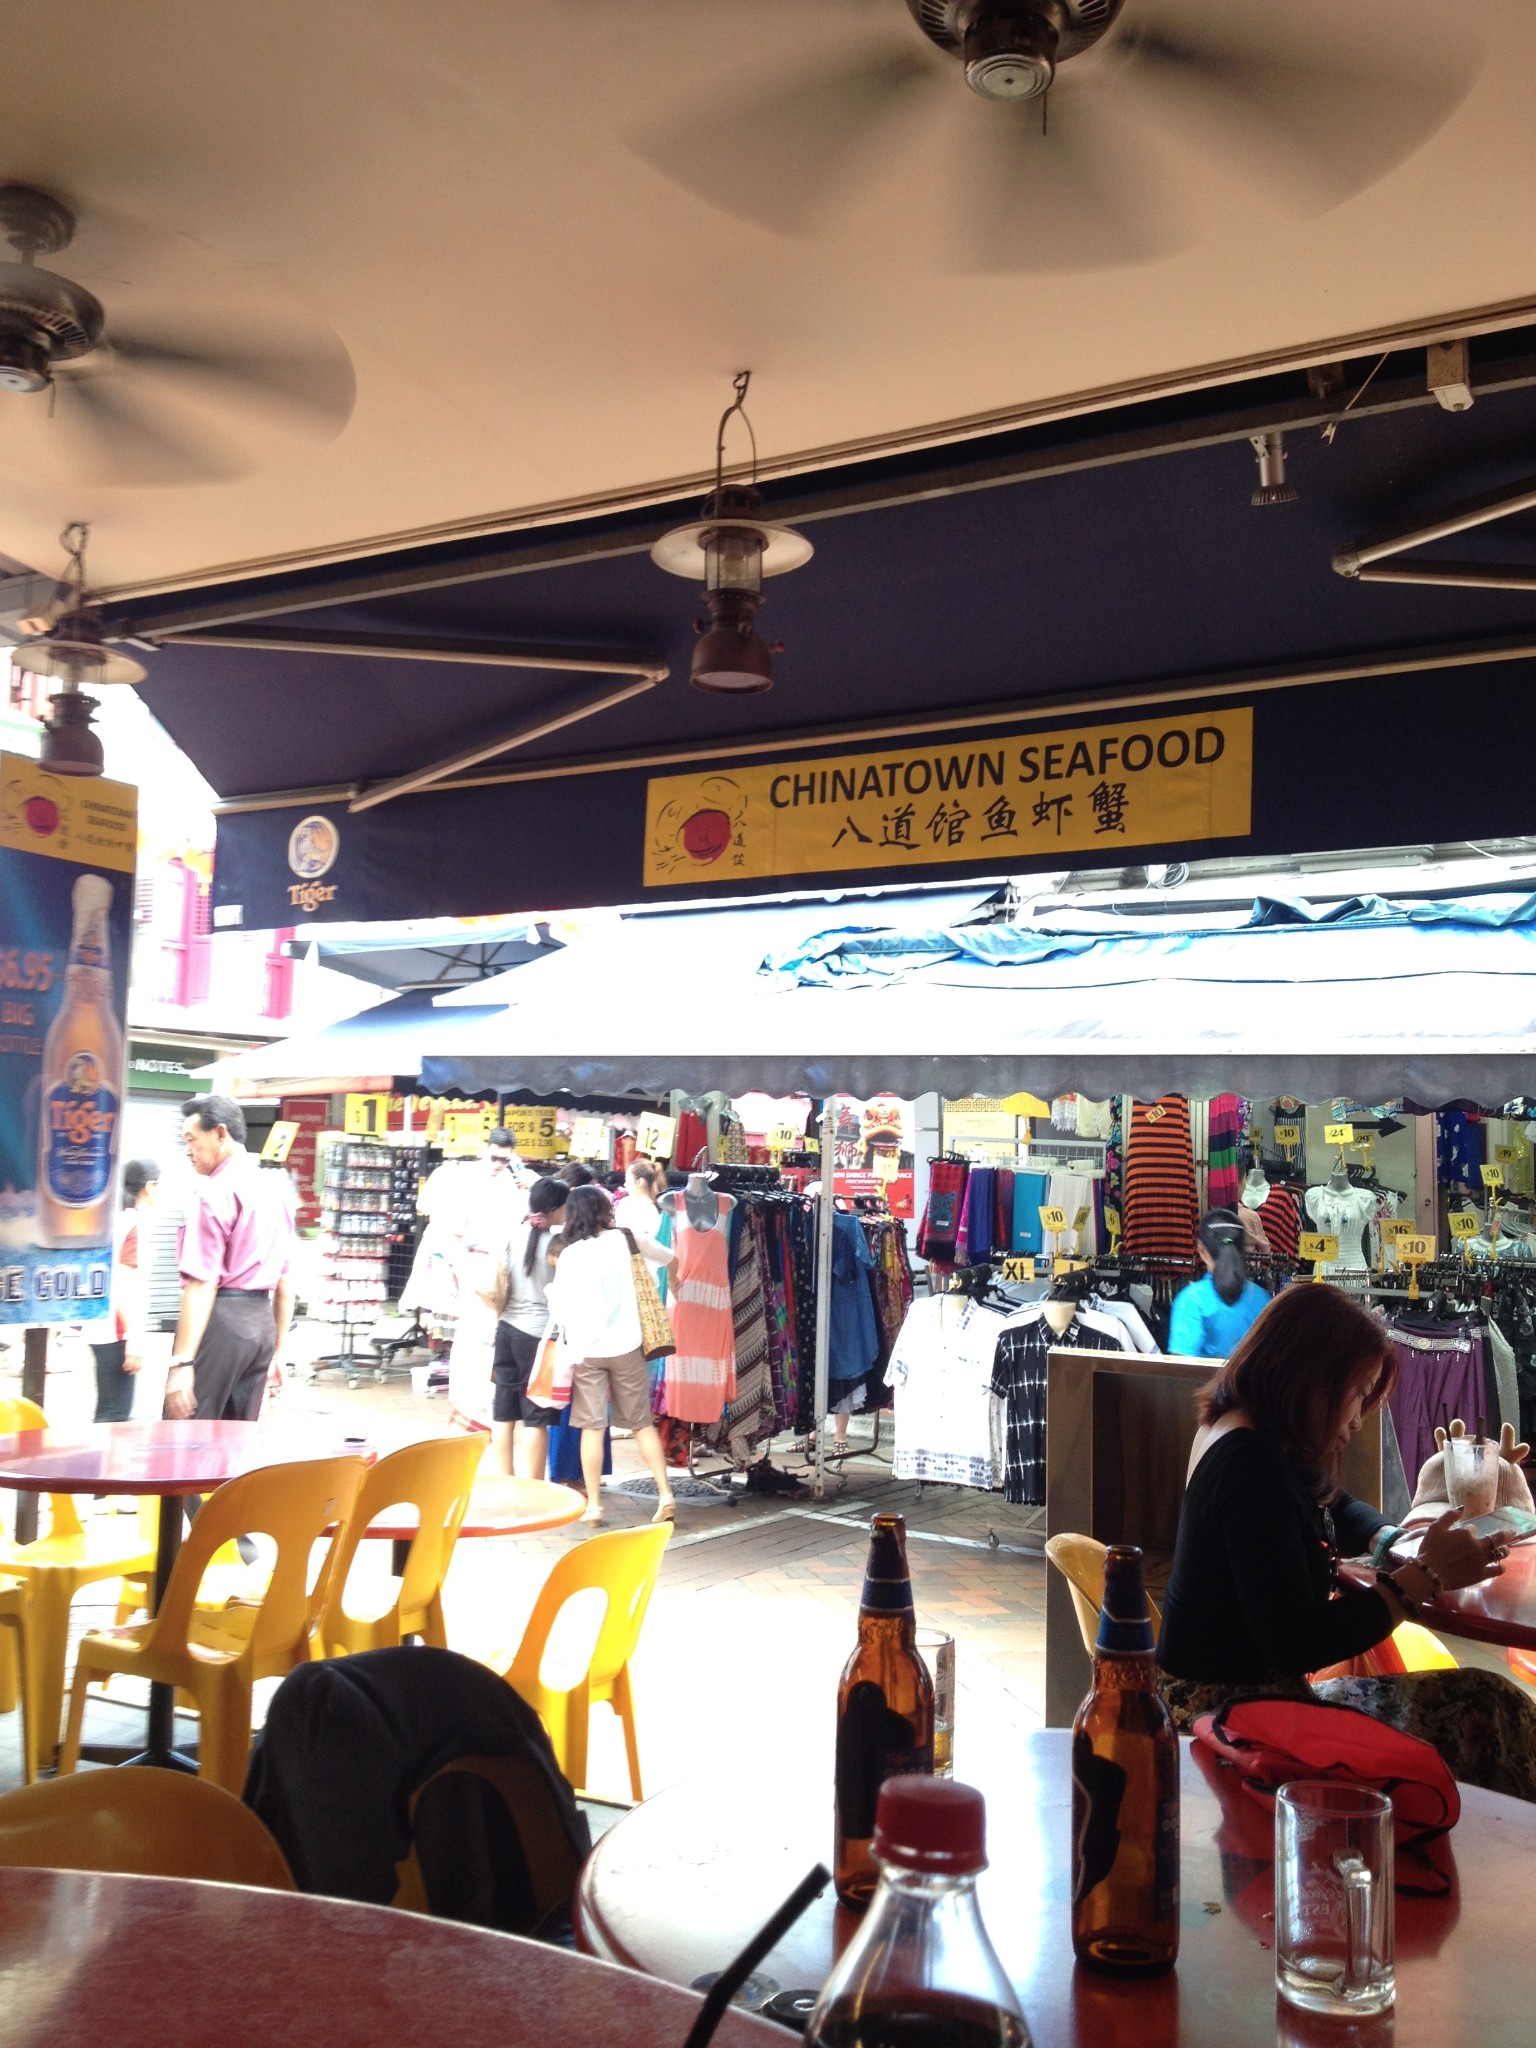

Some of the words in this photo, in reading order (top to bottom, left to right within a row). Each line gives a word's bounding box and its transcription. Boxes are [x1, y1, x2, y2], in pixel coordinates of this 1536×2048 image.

[769, 749, 1005, 809] CHINATOWN
[1018, 725, 1226, 784] SEAFOOD
[831, 780, 1130, 850] 八道馆鱼虾蟹
[287, 881, 339, 912] Tiger
[48, 1099, 115, 1145] Tiger
[539, 1117, 554, 1138] 5
[1457, 1218, 1474, 1230] $10
[1402, 1240, 1426, 1254] $10
[1005, 1262, 1030, 1281] XL
